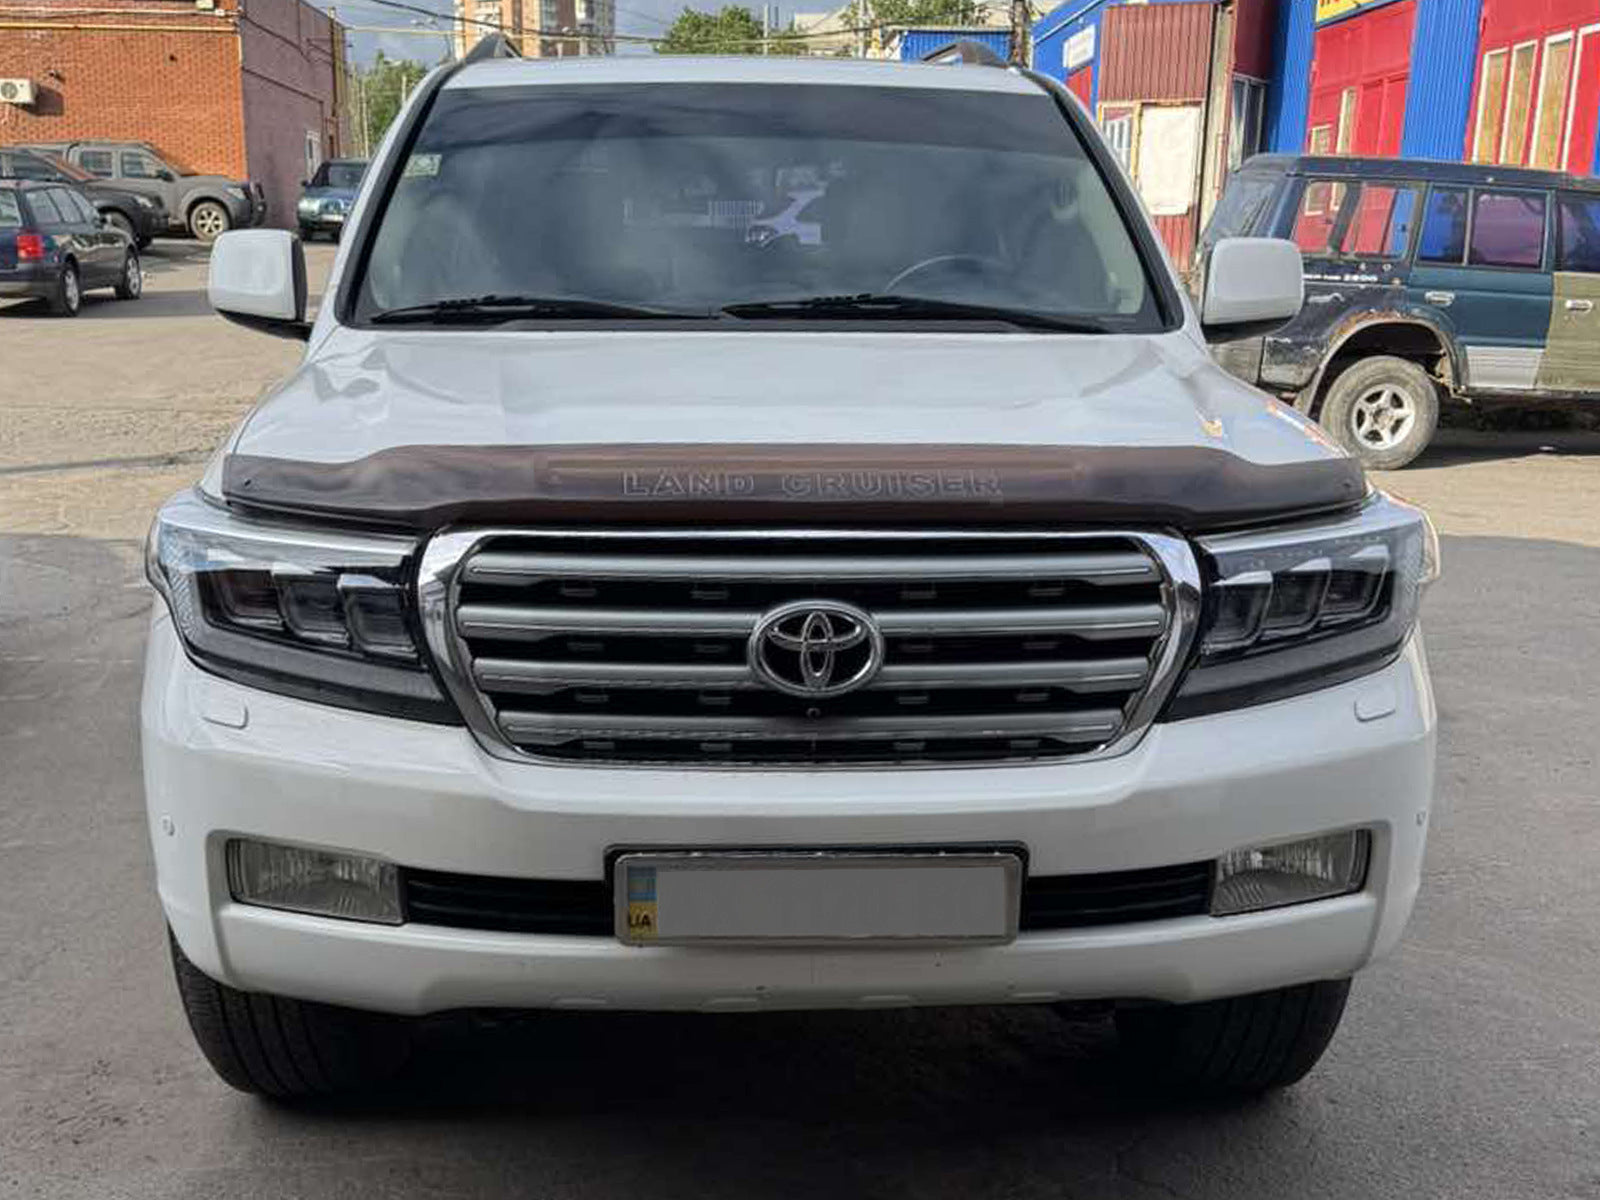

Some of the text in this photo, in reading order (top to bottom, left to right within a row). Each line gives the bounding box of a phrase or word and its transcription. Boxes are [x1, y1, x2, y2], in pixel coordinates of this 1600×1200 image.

[622, 470, 1004, 500] LAND CRUISER
[627, 914, 651, 929] UA
